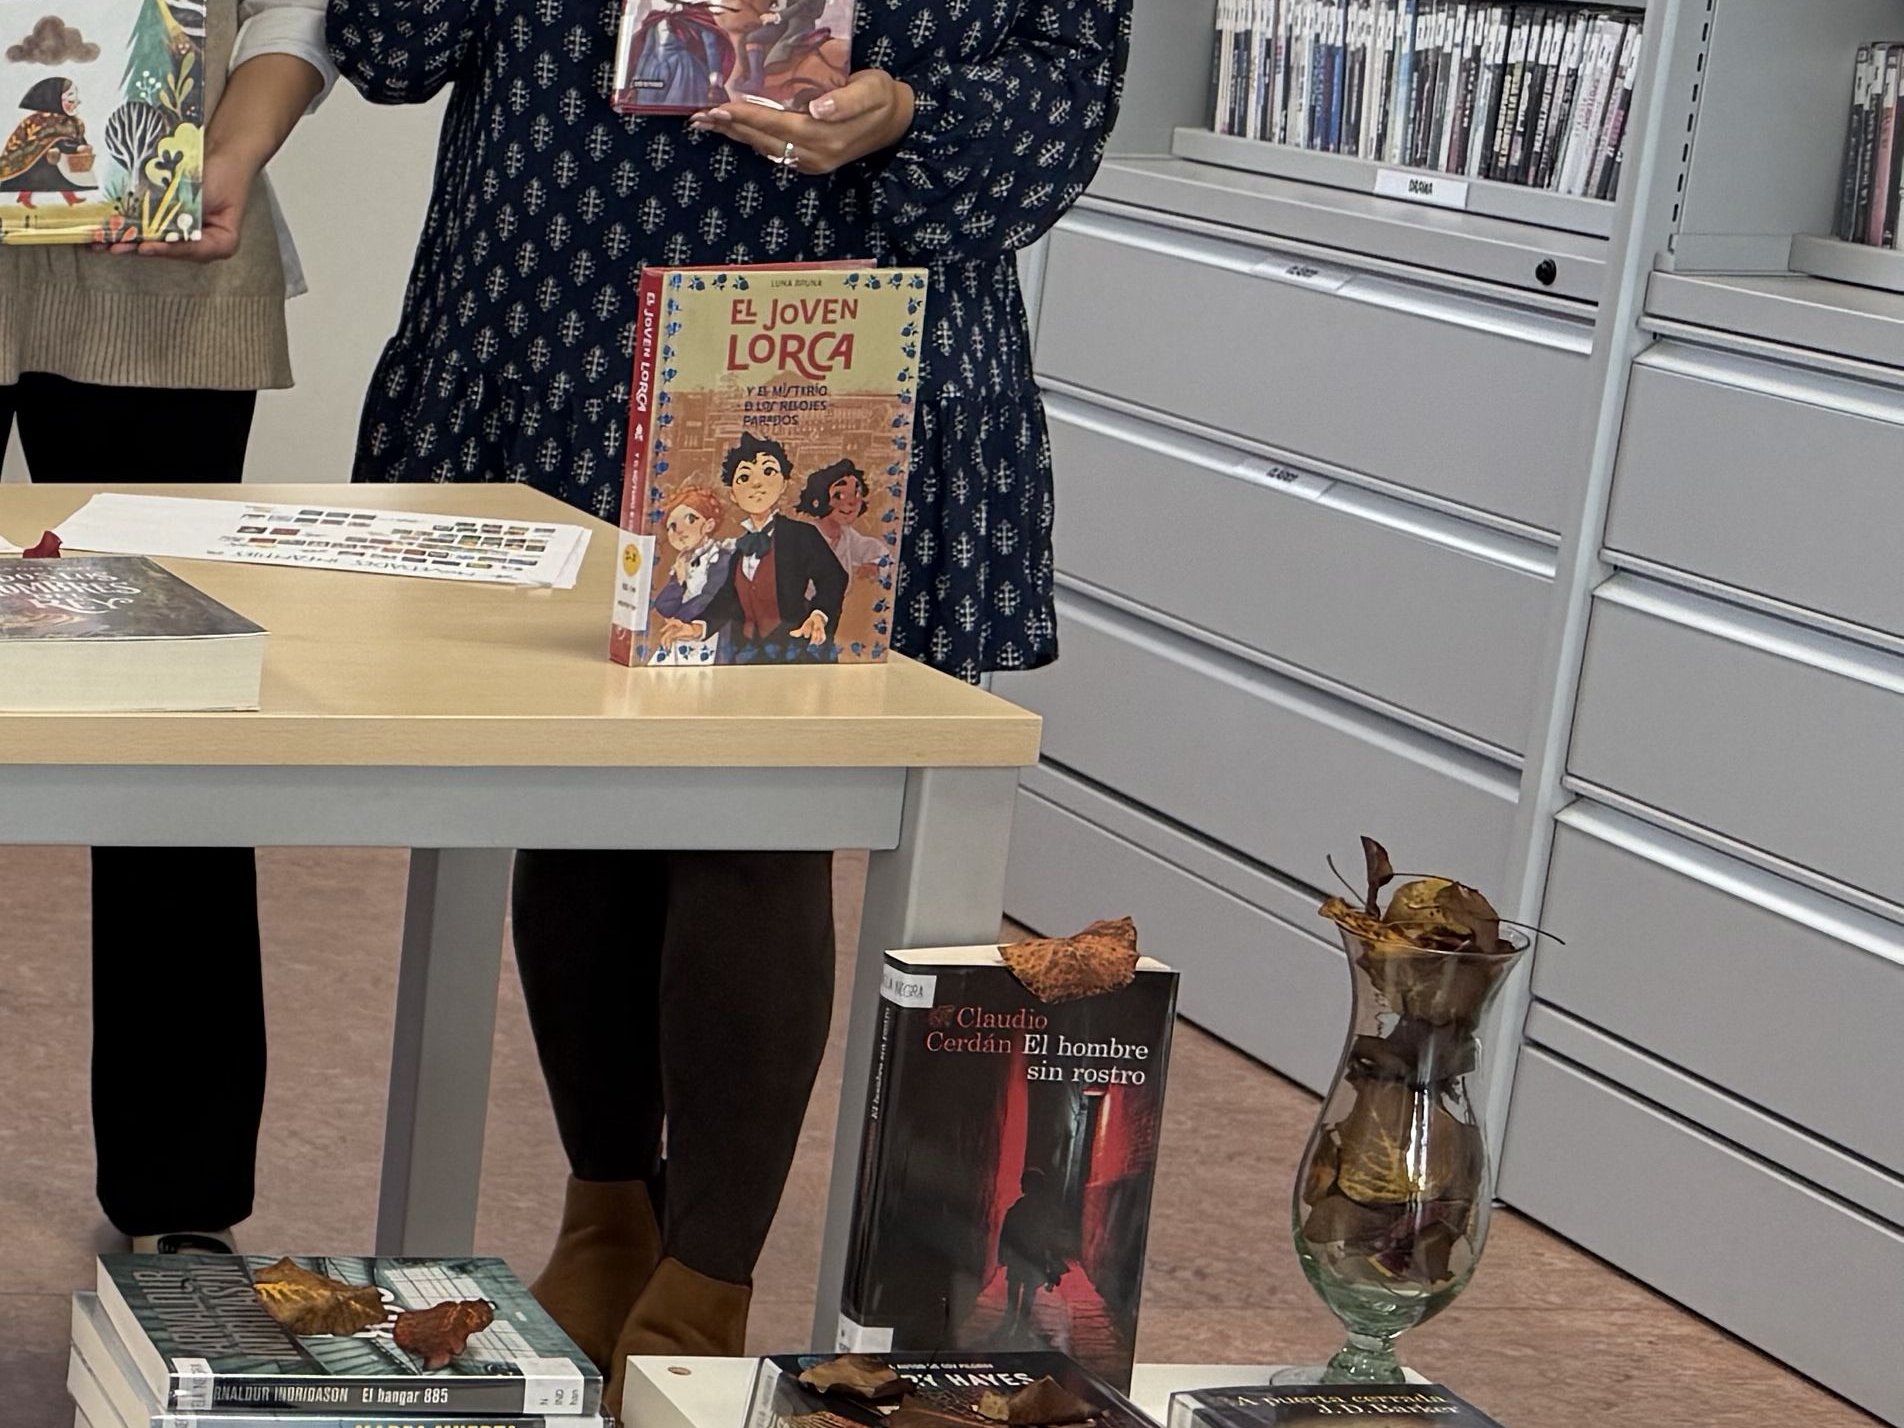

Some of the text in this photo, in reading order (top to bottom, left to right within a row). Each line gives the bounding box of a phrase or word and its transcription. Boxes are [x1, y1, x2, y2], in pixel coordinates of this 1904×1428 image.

[730, 298, 858, 331] EL JOVEN
[636, 291, 655, 412] EL JOVEN LORCA
[727, 331, 855, 380] LORCA
[955, 1007, 1048, 1030] Claudio
[926, 1029, 1149, 1060] Cerdán El hombre
[1026, 1060, 1146, 1086] sin rostro
[947, 1371, 1036, 1388] HAYES
[214, 1385, 271, 1401] RNALDUR
[274, 1386, 348, 1404] INDRIDASON
[362, 1387, 376, 1403] El
[424, 1387, 448, 1404] 885
